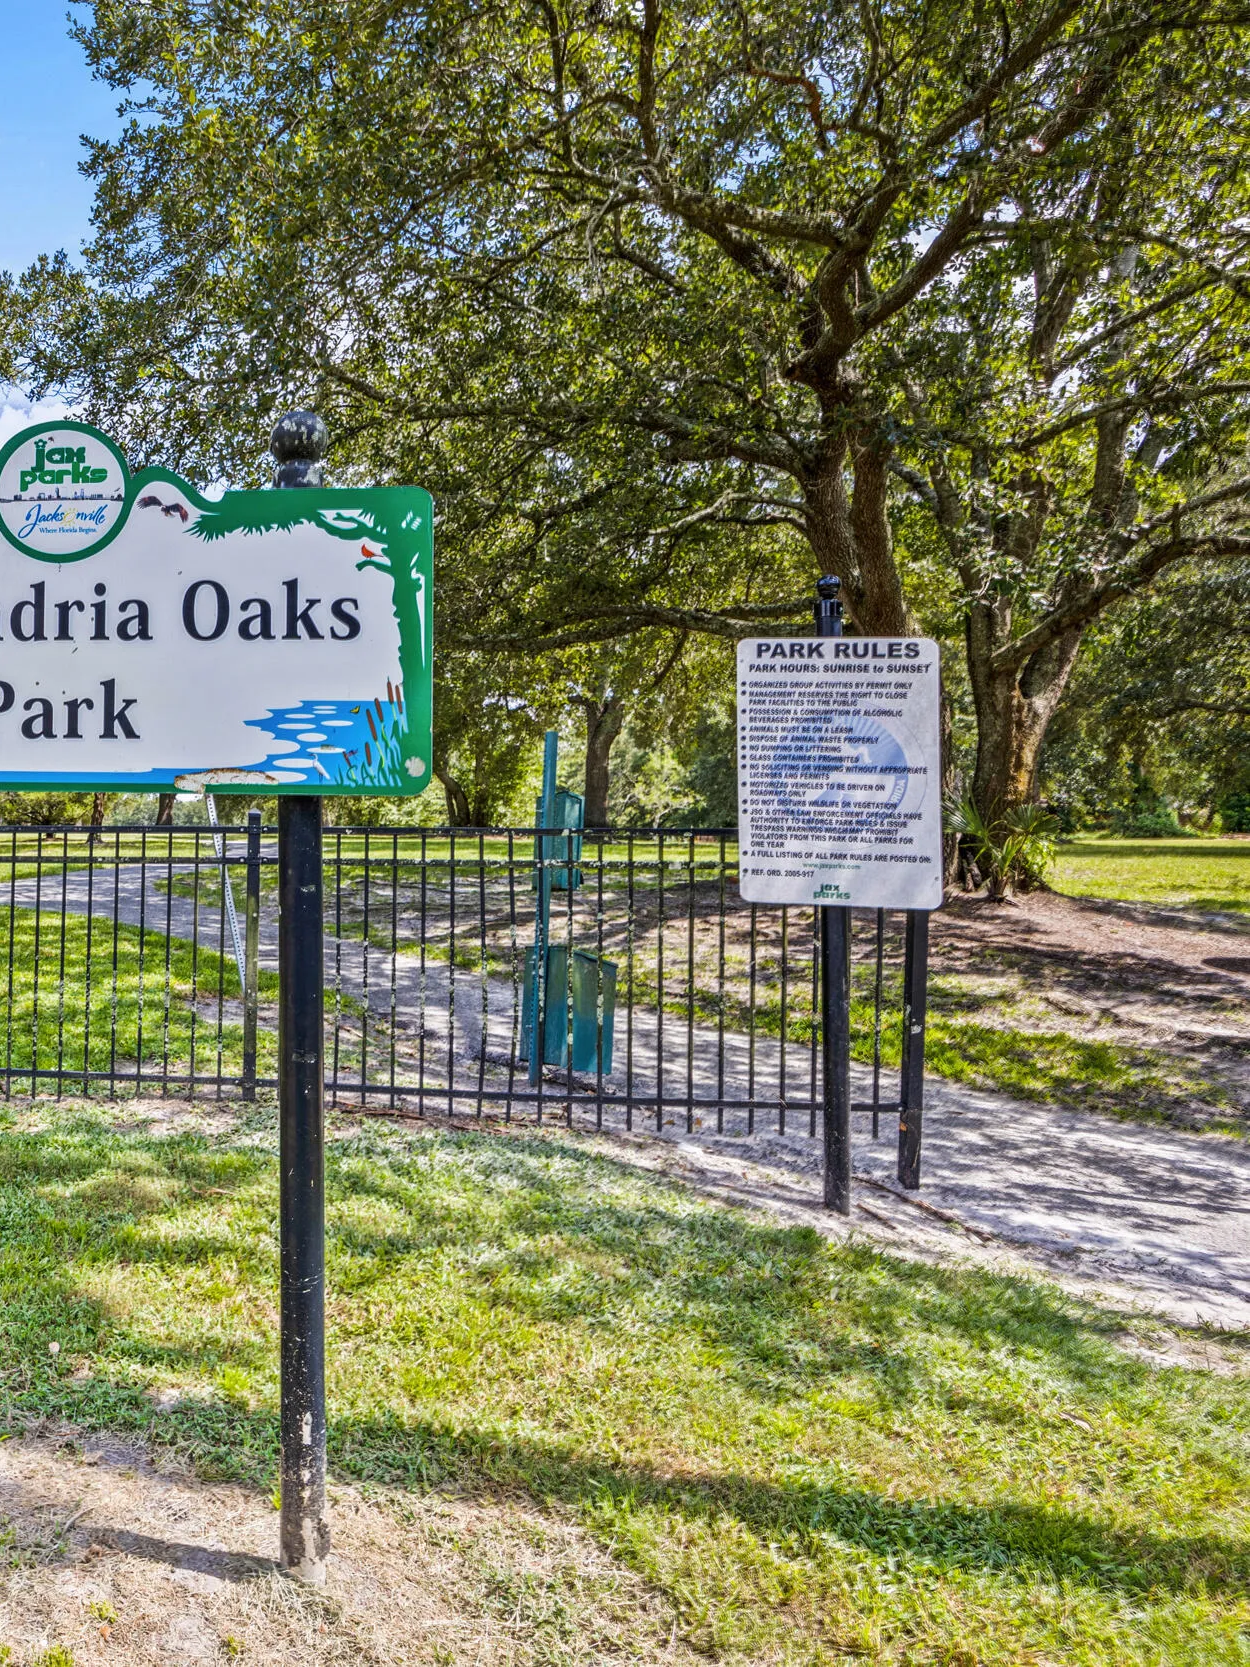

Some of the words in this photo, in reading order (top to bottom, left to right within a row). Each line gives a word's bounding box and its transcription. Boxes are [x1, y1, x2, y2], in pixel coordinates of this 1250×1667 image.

[31, 439, 86, 472] jax
[20, 461, 108, 492] parks
[18, 503, 108, 538] Jacksonville
[182, 578, 362, 642] Oaks
[756, 642, 825, 659] PARK
[834, 642, 920, 660] RULES
[749, 664, 777, 673] PARK
[780, 664, 820, 673] HOURS:
[823, 664, 870, 673] SUNRISE
[873, 665, 884, 673] to
[886, 664, 932, 674] SUNSET
[818, 735, 842, 743] WASTE
[843, 736, 879, 744] PROPERLY
[818, 754, 860, 763] PROHIBITED
[879, 766, 927, 774] APPROPRIATE
[853, 801, 897, 809] VEGETATION
[813, 810, 863, 818] ENFORCEMENT
[866, 811, 901, 819] OFFICIALS
[865, 828, 898, 836] PROHIBIT
[873, 854, 888, 862] ARE
[890, 854, 917, 863] POSTED
[820, 883, 840, 892] jax
[813, 890, 850, 899] parks
